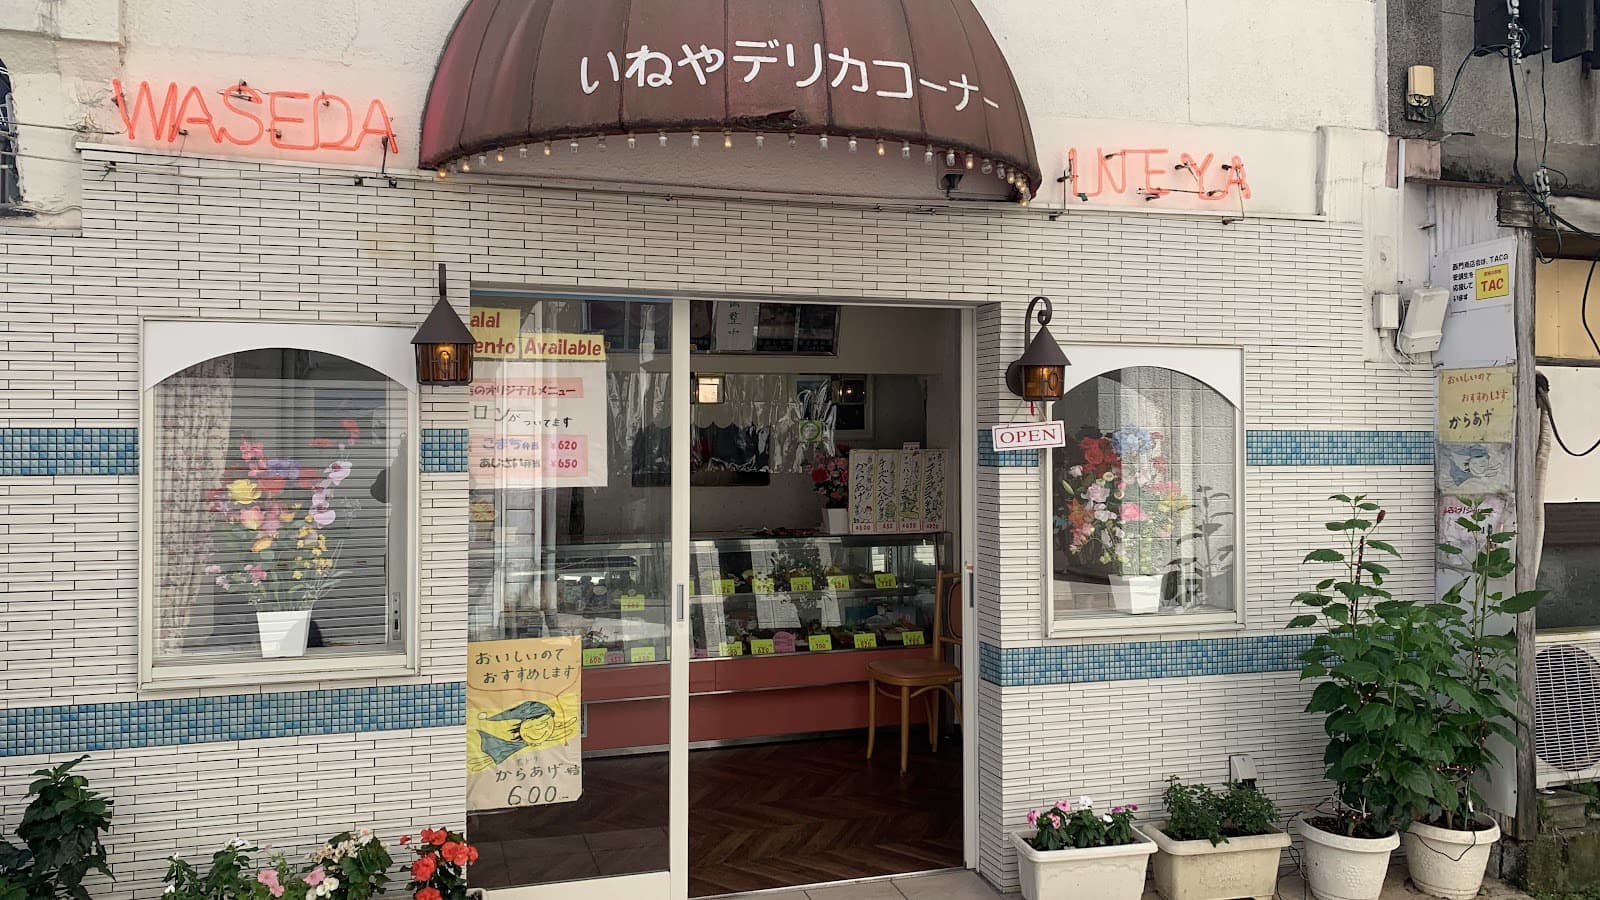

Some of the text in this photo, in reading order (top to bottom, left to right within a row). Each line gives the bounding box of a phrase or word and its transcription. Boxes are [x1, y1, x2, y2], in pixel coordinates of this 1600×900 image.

[580, 39, 999, 111] いねやデリカコーナー
[112, 79, 399, 154] WASEDA
[1480, 278, 1504, 293] TAC
[470, 311, 500, 329] alal
[475, 337, 602, 356] ento Available
[1448, 408, 1495, 430] からあげ
[1000, 428, 1056, 444] OPEN
[483, 665, 576, 684] おすすめします
